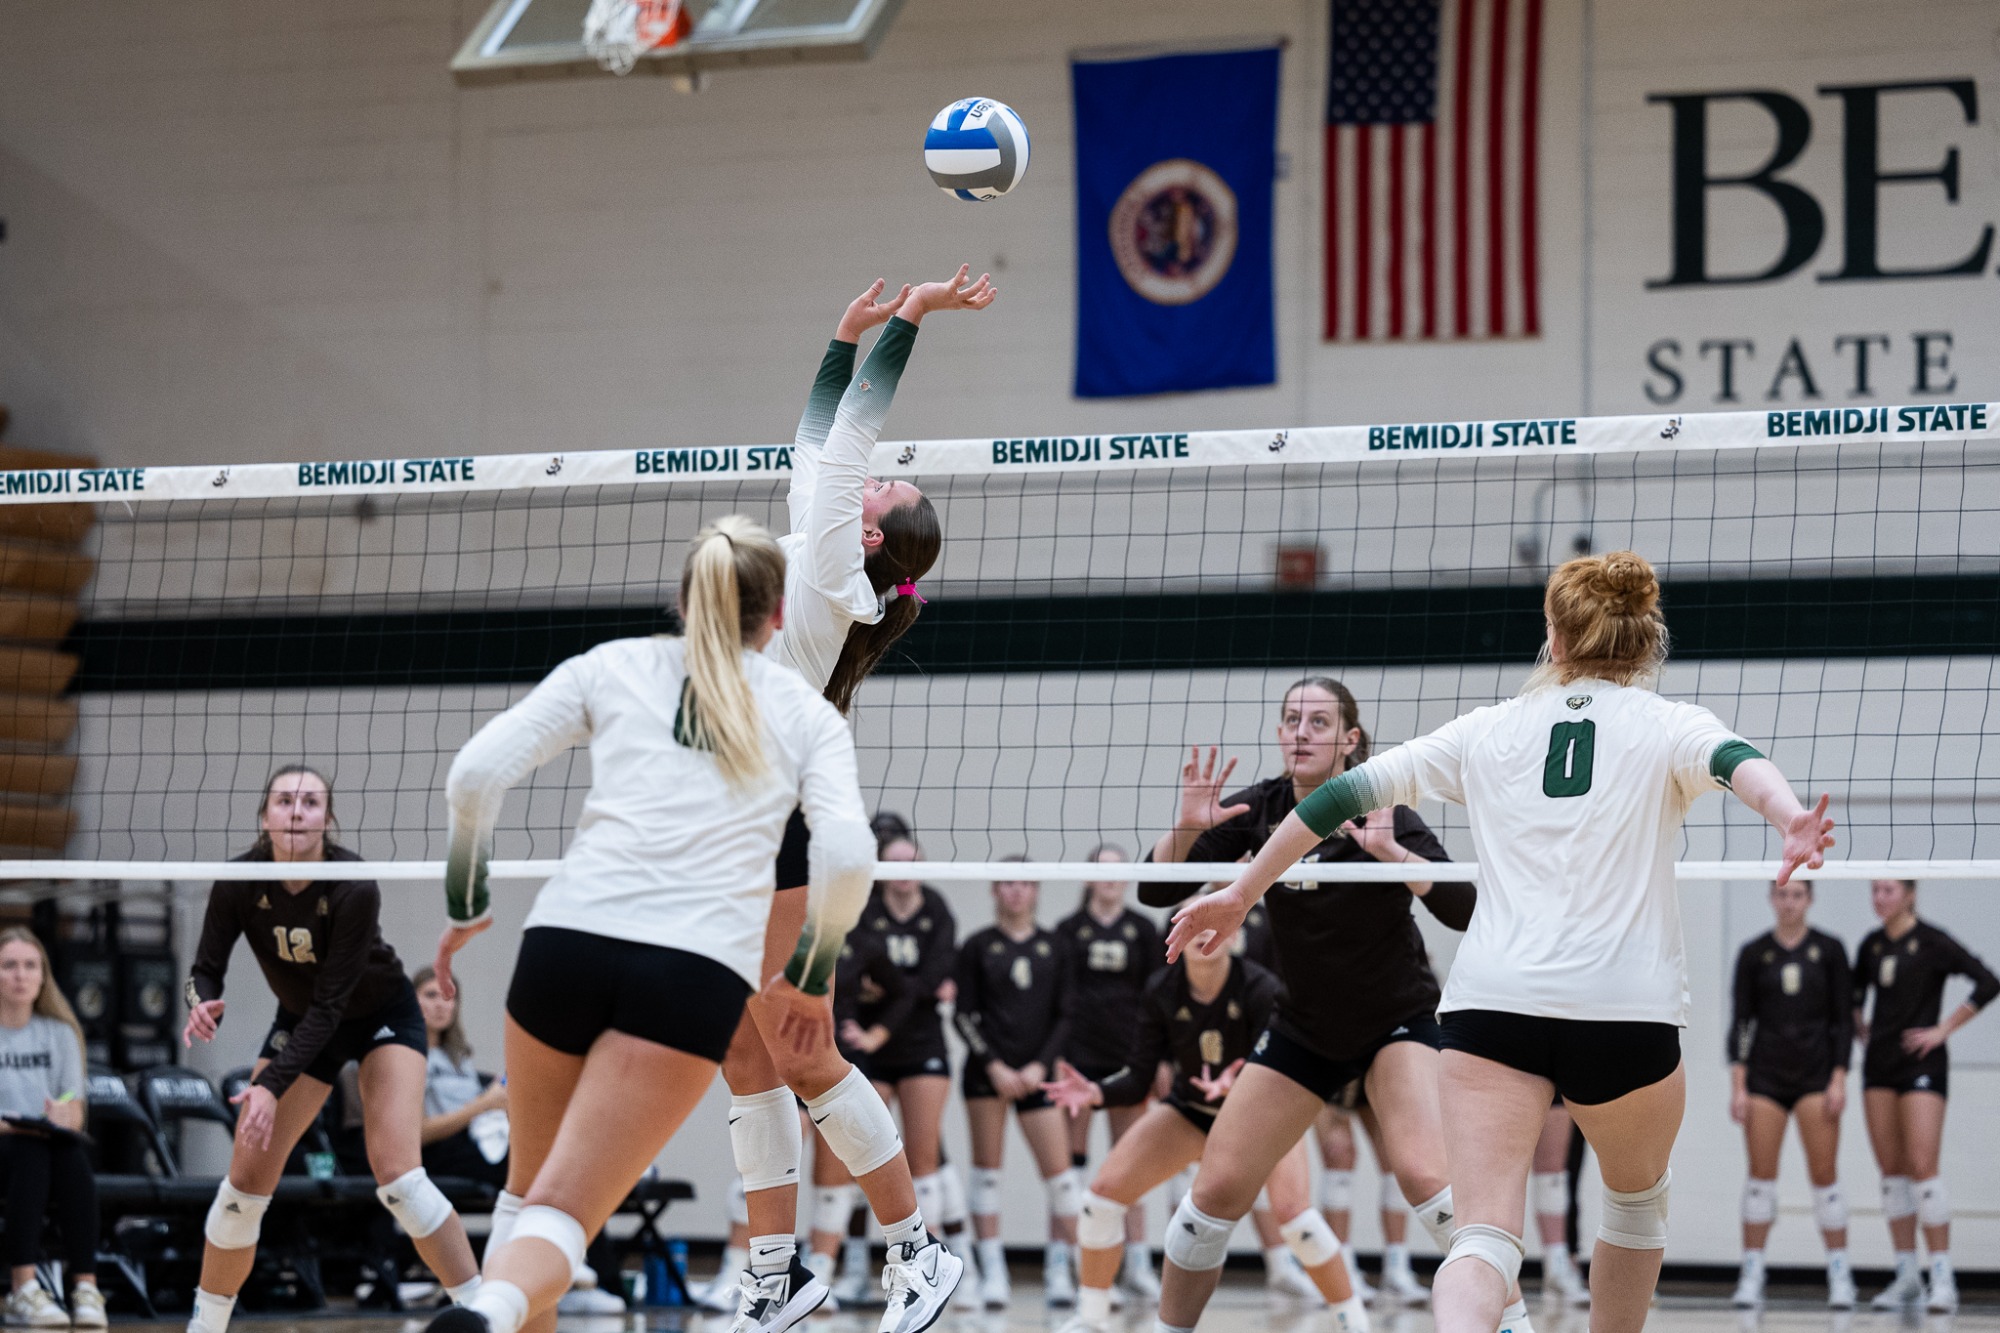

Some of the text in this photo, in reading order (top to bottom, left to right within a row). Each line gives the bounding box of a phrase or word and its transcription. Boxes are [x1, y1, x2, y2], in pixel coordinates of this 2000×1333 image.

[1645, 78, 2000, 291] BE
[1642, 330, 1958, 406] STATE
[1368, 420, 1577, 451] BEMIDJI STATE
[1767, 403, 1987, 438] BEMIDJI STATE
[635, 446, 796, 474] BEMIDJI STA
[992, 434, 1190, 464] BEMIDJI STATE
[77, 467, 146, 492] STATE
[298, 458, 475, 486] BEMIDJI STATE
[1543, 718, 1596, 798] 0
[273, 925, 317, 964] 12
